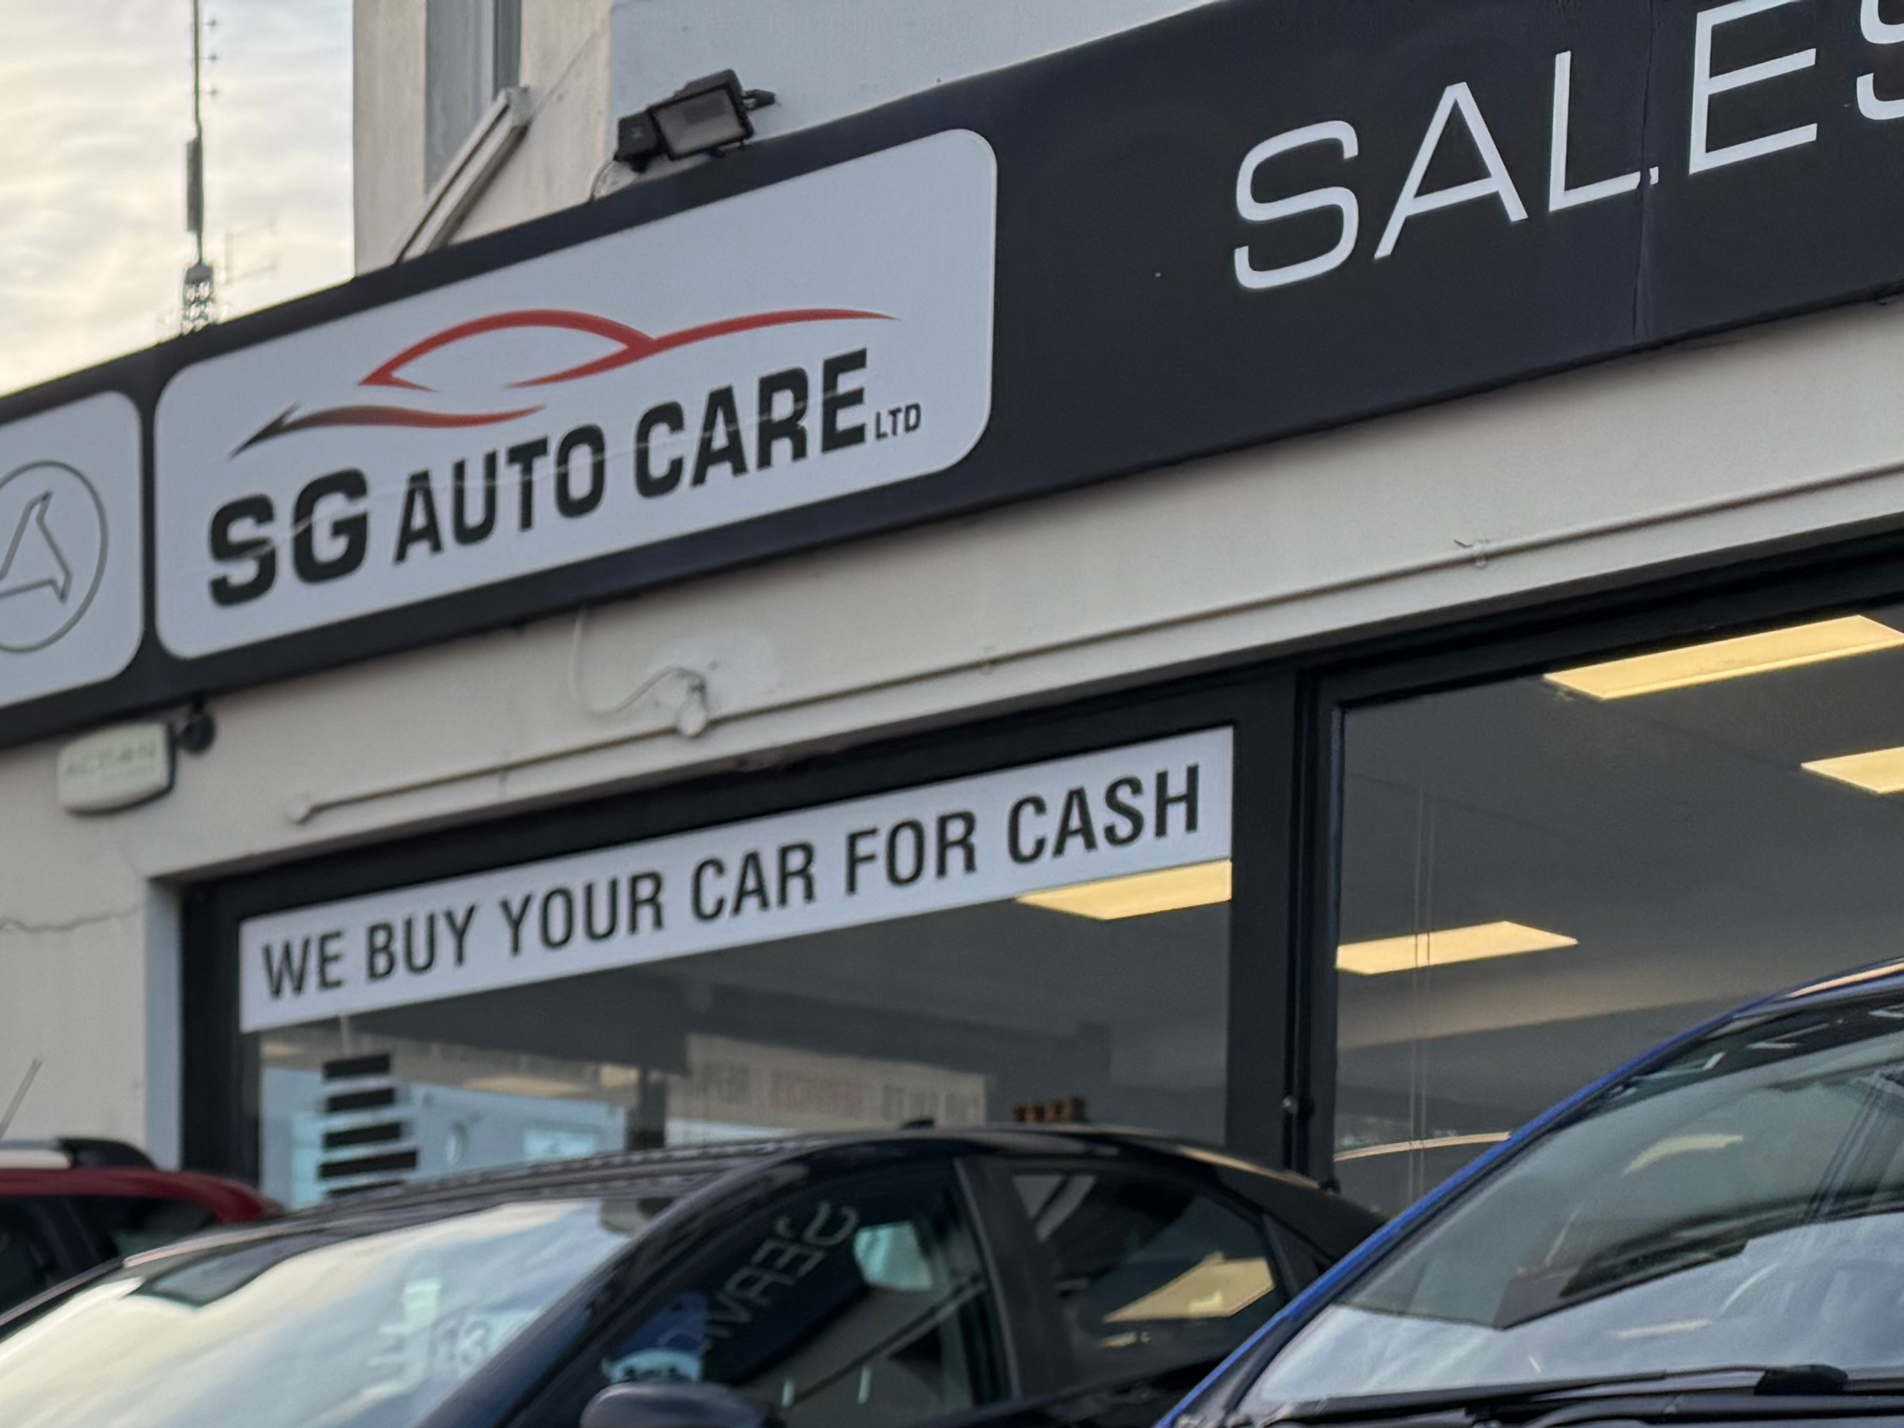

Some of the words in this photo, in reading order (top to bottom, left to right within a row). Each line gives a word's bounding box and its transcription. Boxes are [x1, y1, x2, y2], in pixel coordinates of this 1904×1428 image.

[208, 467, 370, 608] SG
[395, 425, 609, 566] AUTO
[634, 350, 869, 500] CARE
[874, 398, 923, 442] LTD
[262, 931, 345, 999] WE
[365, 905, 477, 982] BUY
[498, 872, 664, 958] YOUR
[690, 842, 817, 922] CAR
[843, 811, 976, 896] FOR
[1006, 764, 1201, 865] CASH
